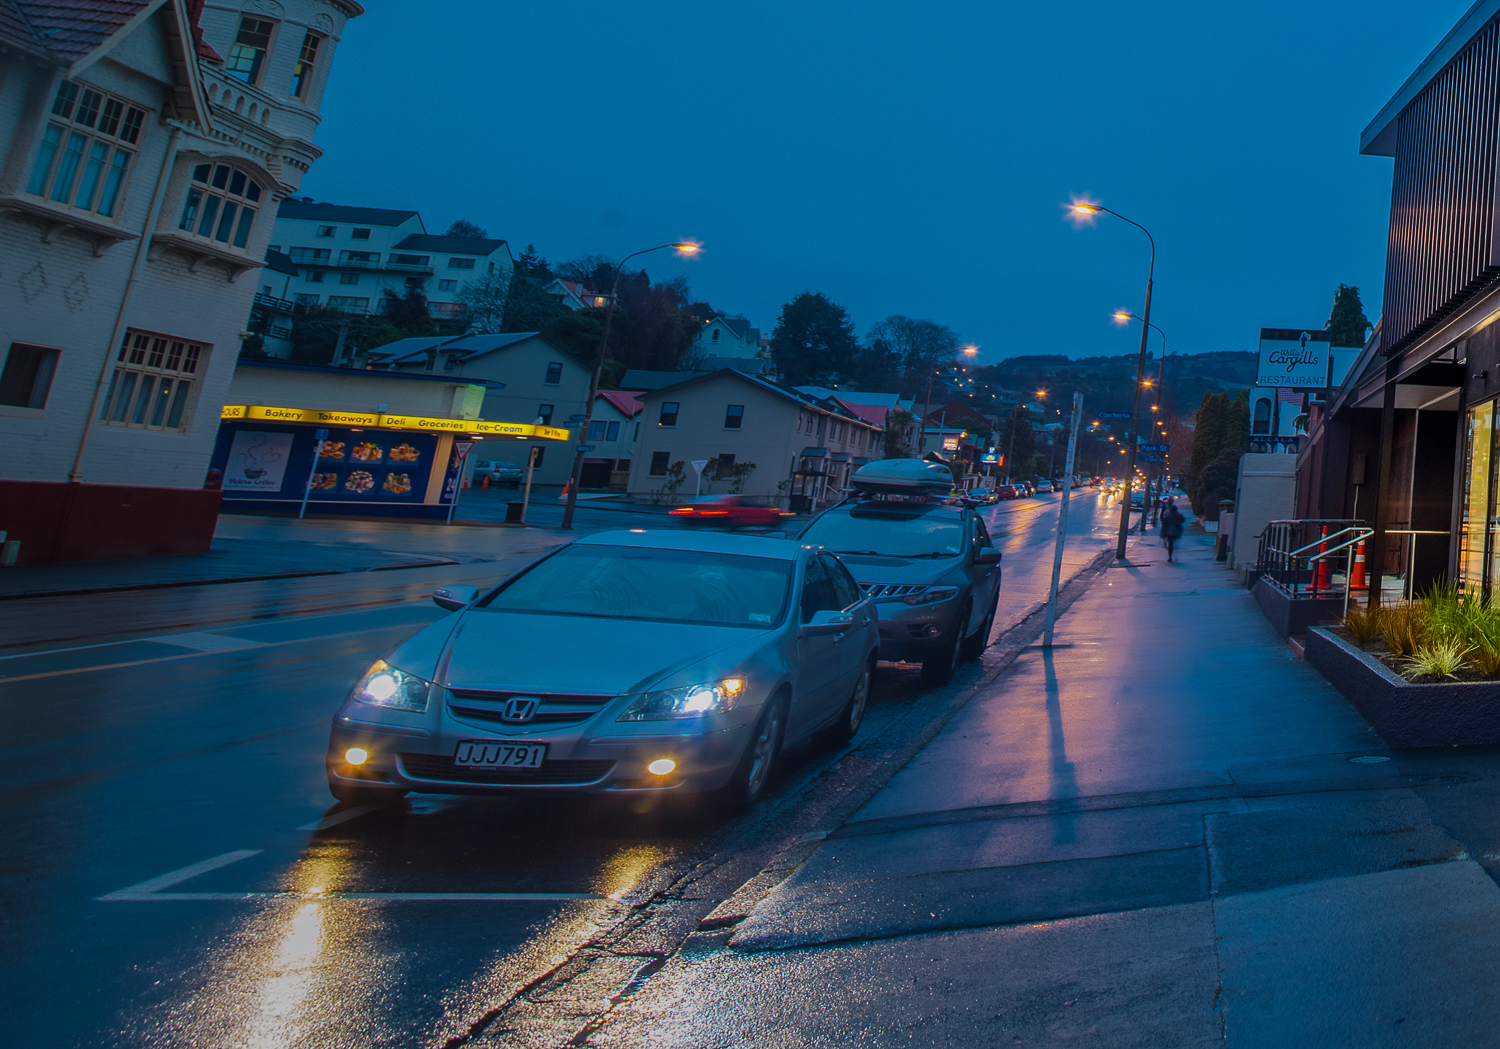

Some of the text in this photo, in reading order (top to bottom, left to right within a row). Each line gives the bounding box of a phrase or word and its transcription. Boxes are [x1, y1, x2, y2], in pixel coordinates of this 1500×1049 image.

[1268, 351, 1319, 373] Cargills
[1260, 375, 1326, 385] RESTAURANT
[222, 407, 241, 417] OURS
[265, 409, 523, 433] Bakery Takeaways Deli Groceries Ice-Cream
[1141, 444, 1168, 452] Park St
[458, 745, 540, 765] JJJ791
